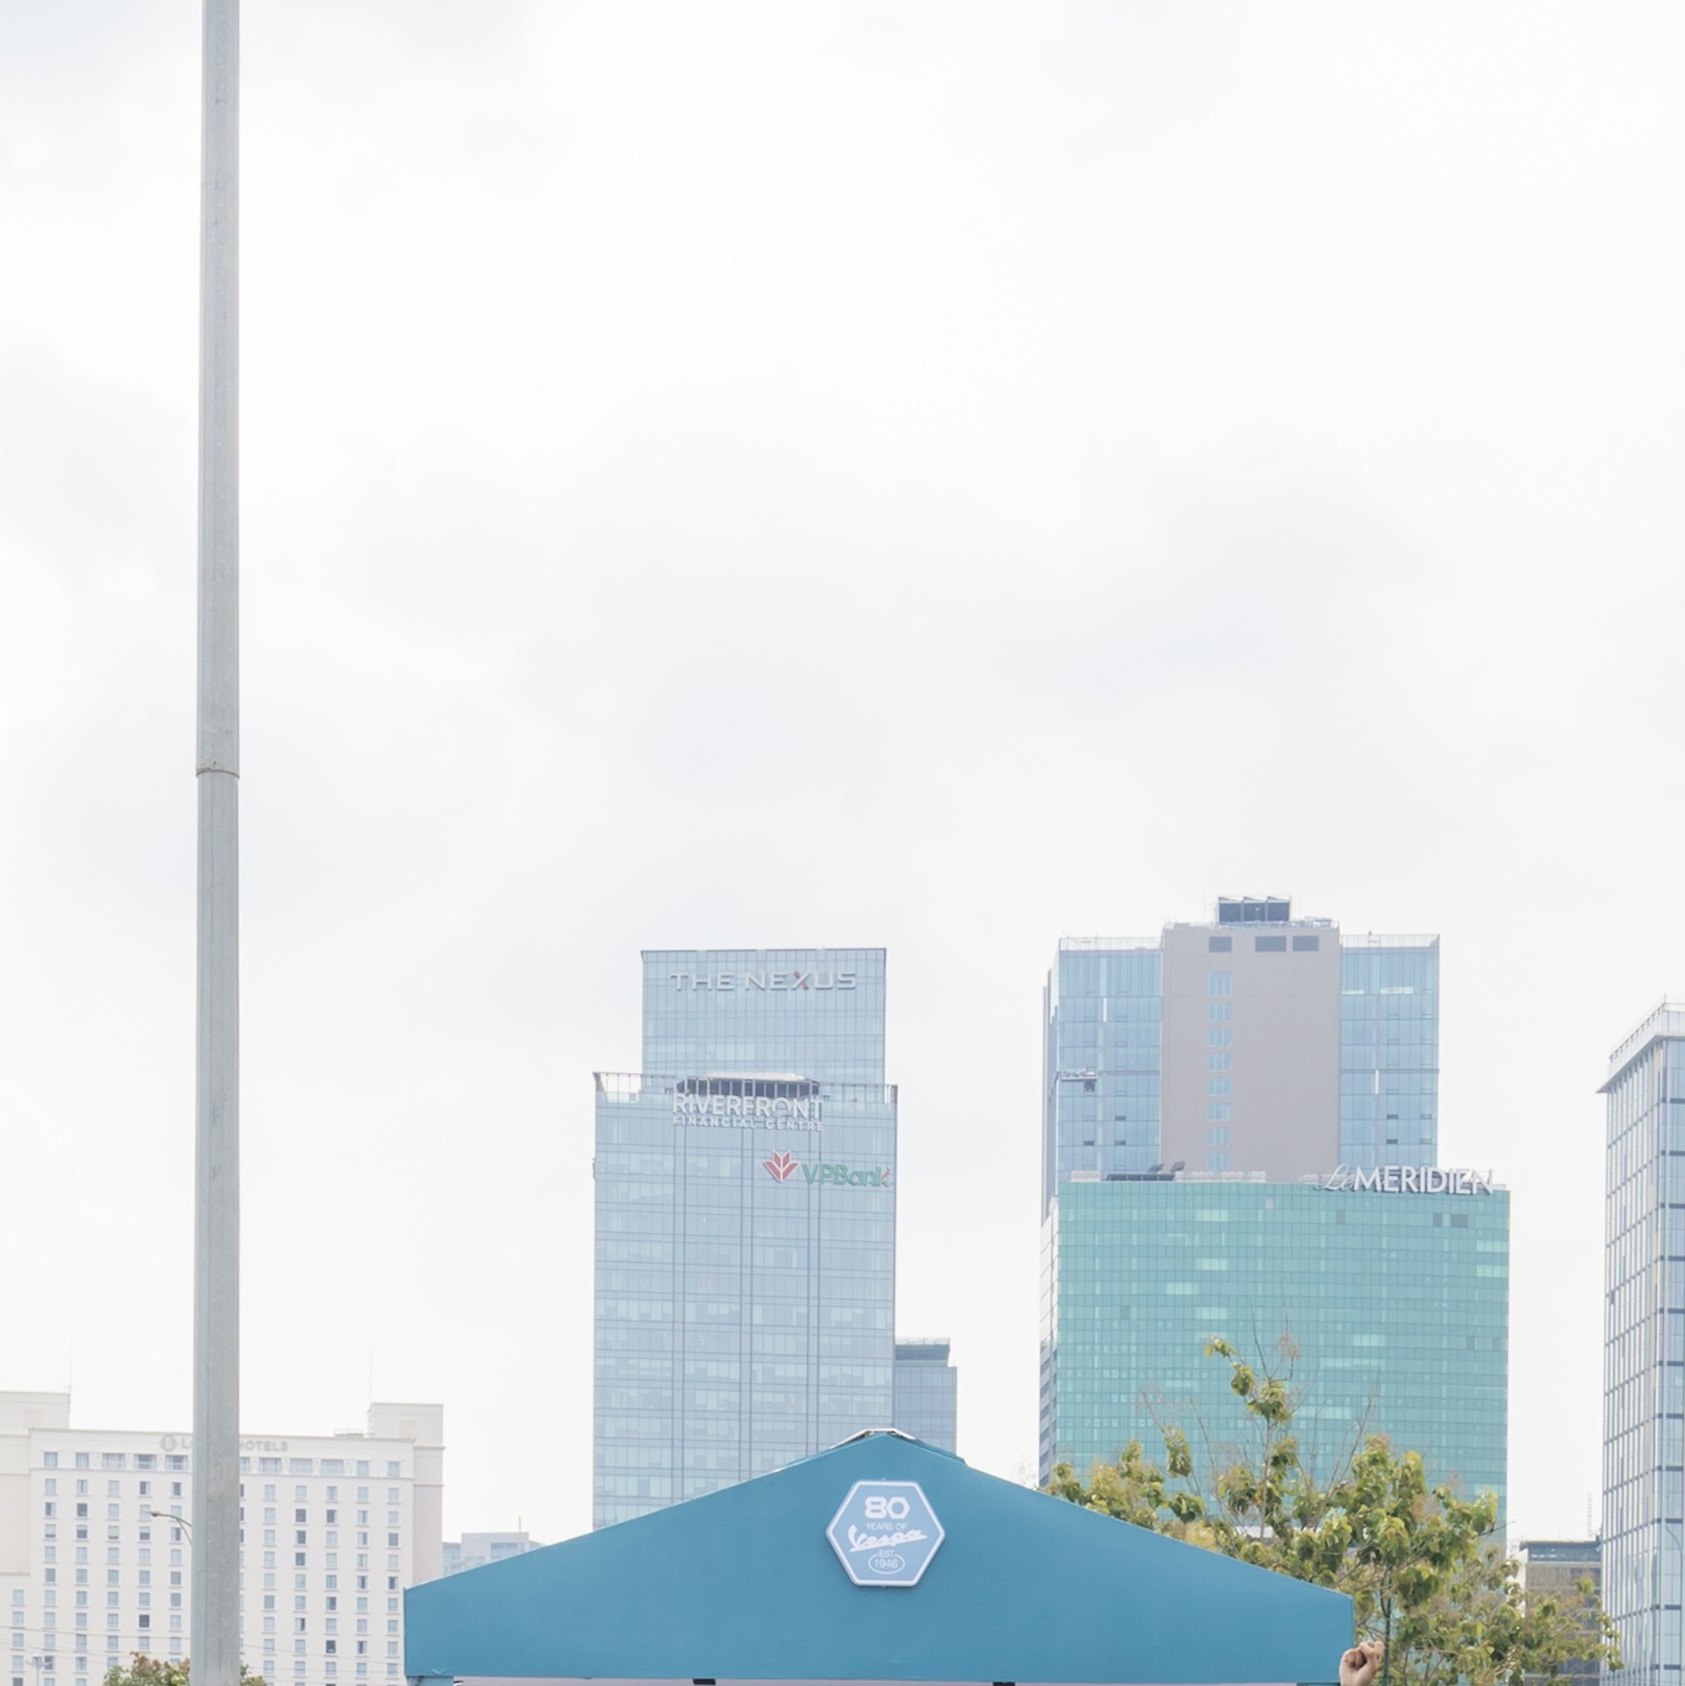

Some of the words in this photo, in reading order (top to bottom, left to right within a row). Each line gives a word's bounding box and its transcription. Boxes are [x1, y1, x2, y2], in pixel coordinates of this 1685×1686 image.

[671, 972, 735, 991] THE
[744, 971, 857, 991] NEXUS
[672, 1094, 824, 1120] RIVERFRONT
[672, 1117, 757, 1129] FINANCIAL
[765, 1119, 824, 1132] CENTRE
[801, 1163, 891, 1187] VPBank
[1353, 1165, 1494, 1195] MERIDIEN
[864, 1496, 911, 1519] 80
[865, 1521, 894, 1531] YEARS
[895, 1521, 908, 1531] OF
[848, 1524, 928, 1553] Vespa
